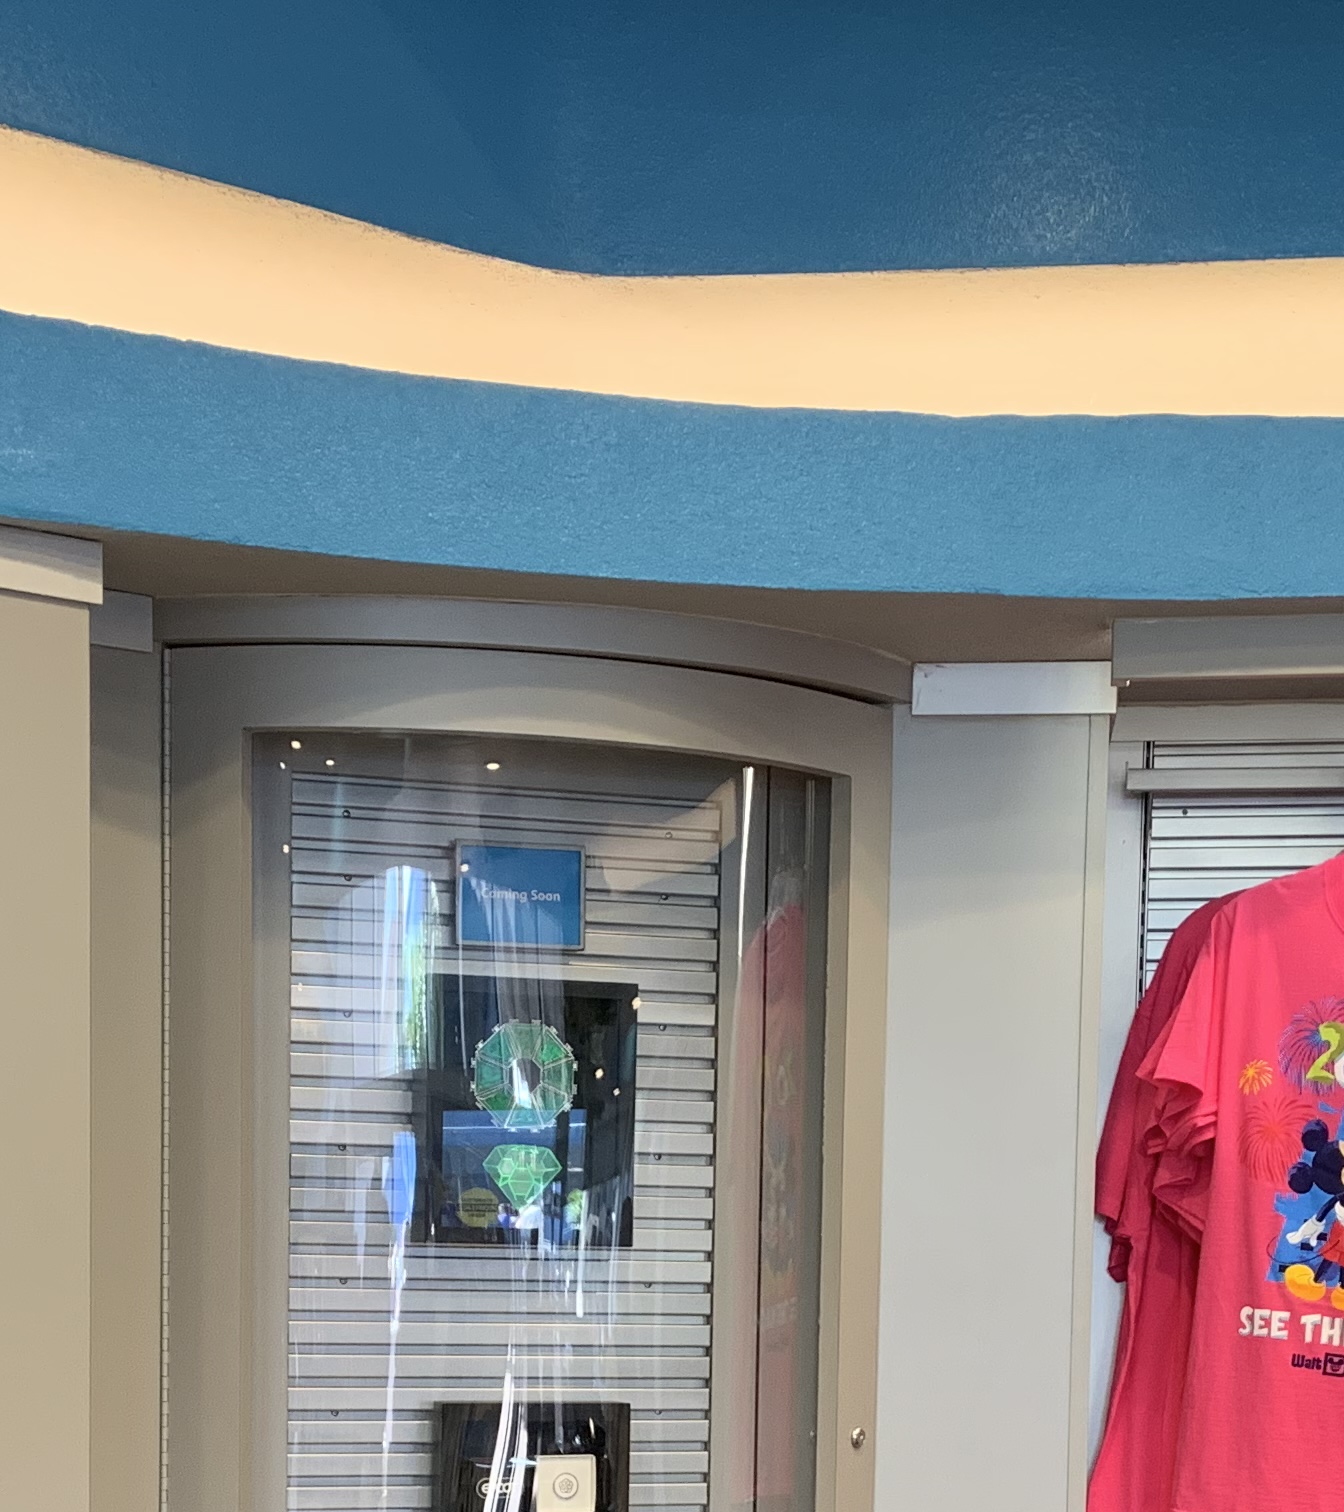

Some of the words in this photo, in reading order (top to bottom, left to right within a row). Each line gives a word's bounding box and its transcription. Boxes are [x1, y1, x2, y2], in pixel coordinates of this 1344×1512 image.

[481, 887, 527, 903] Coming
[531, 889, 561, 902] Soon
[1238, 1305, 1291, 1340] SEE
[1291, 1353, 1322, 1370] Walt
